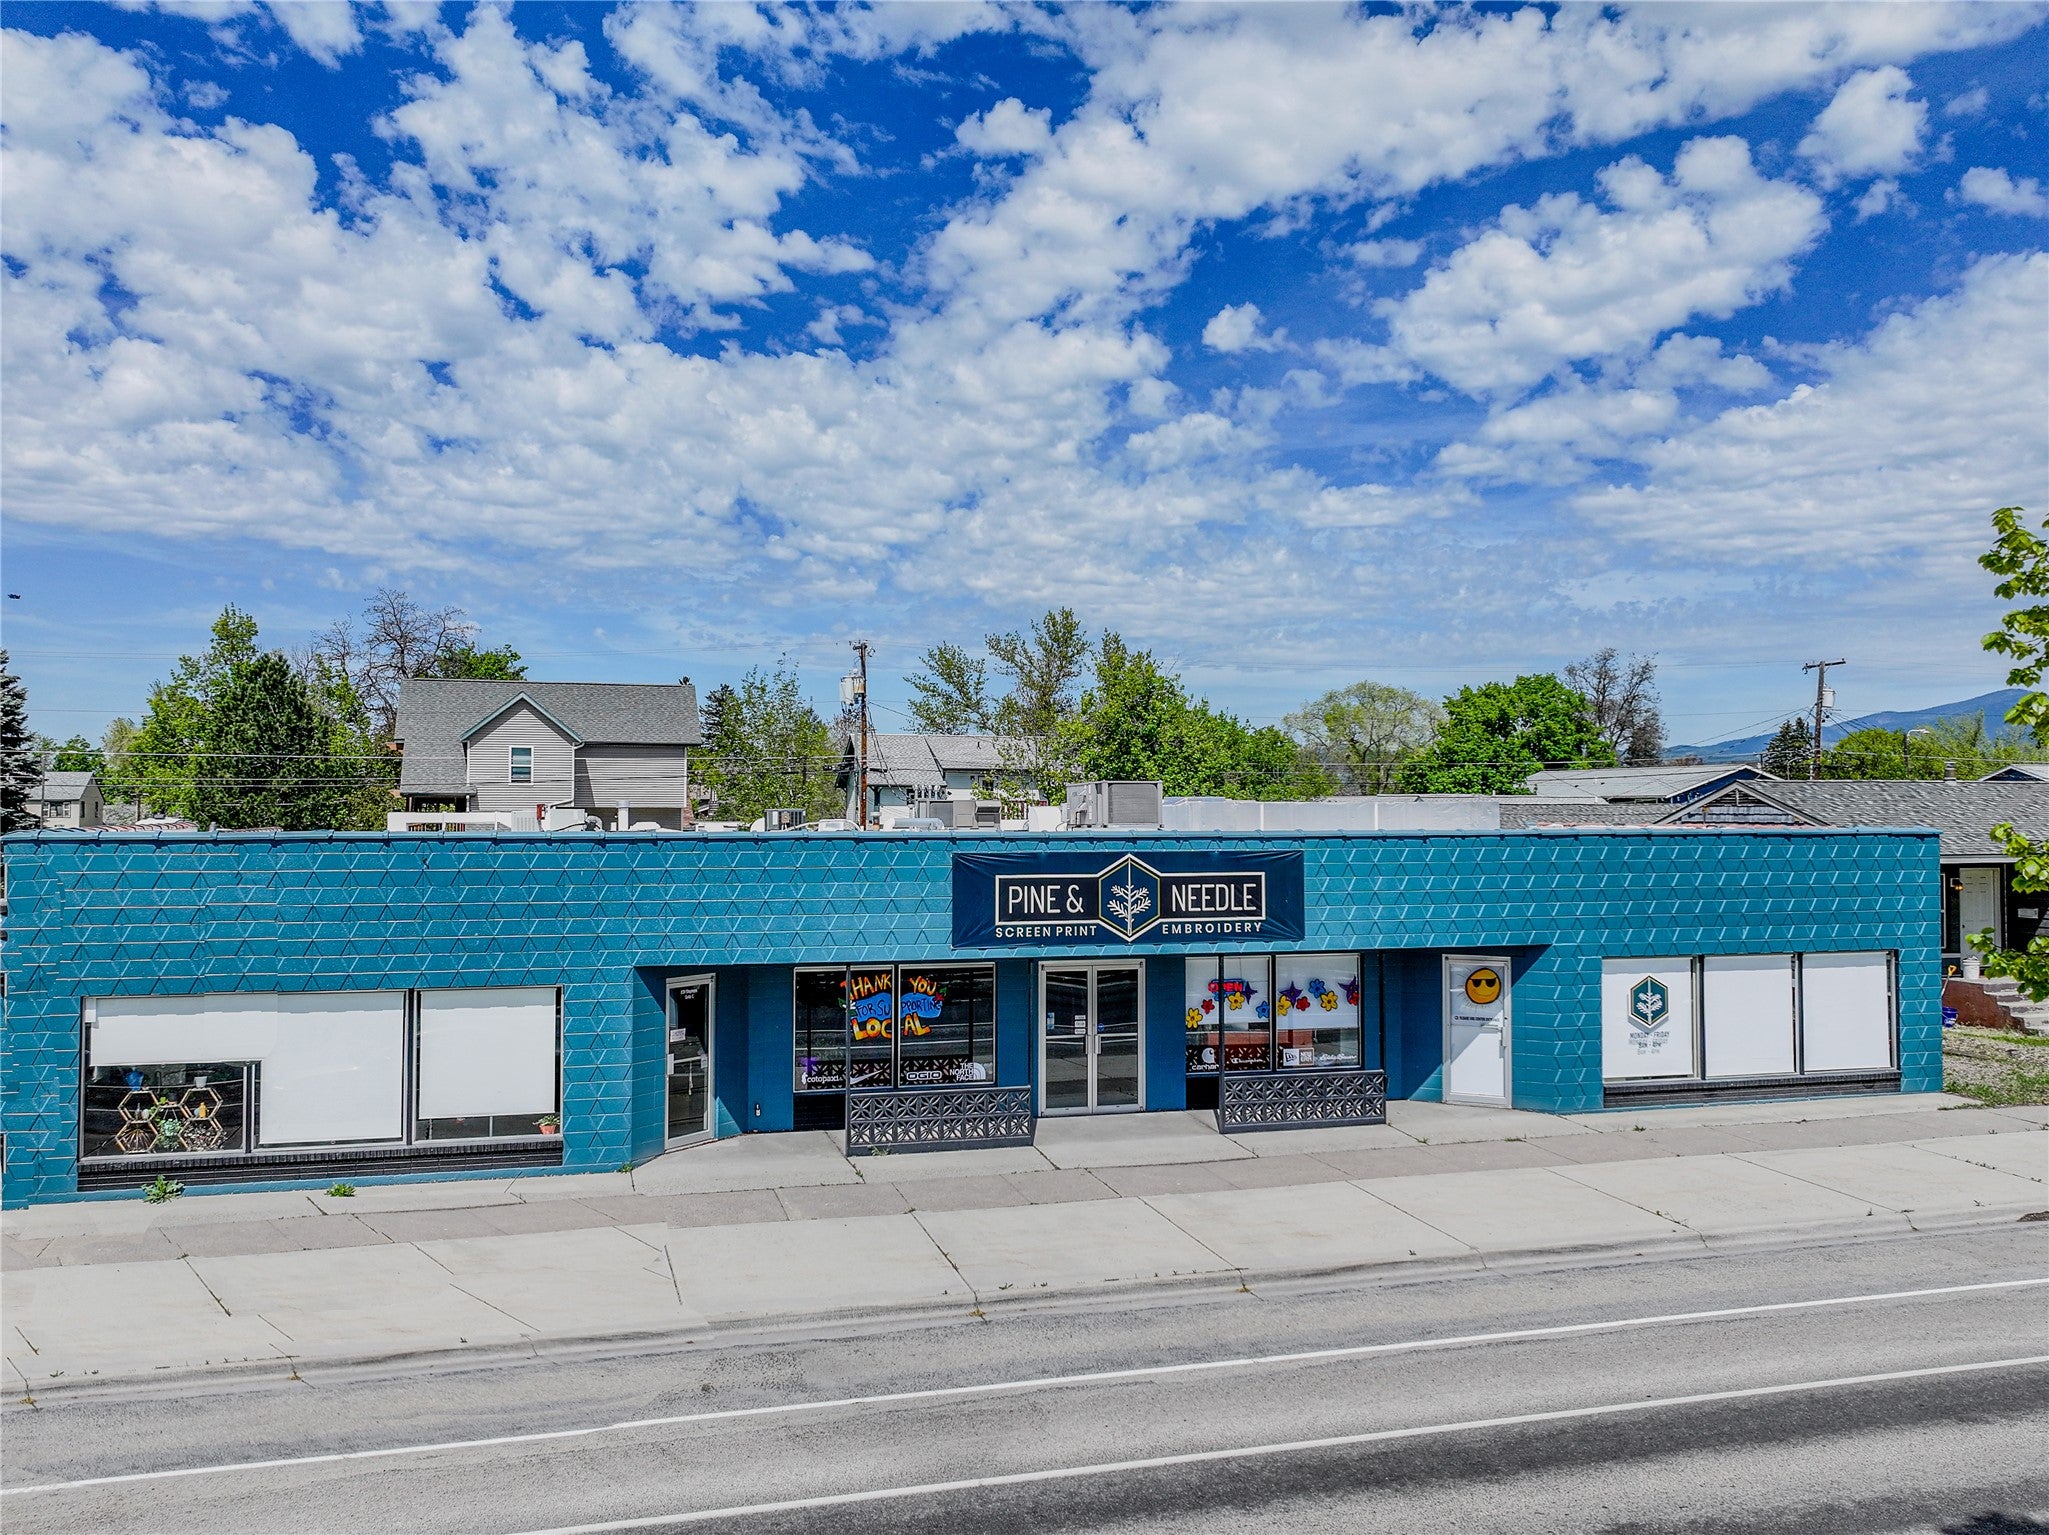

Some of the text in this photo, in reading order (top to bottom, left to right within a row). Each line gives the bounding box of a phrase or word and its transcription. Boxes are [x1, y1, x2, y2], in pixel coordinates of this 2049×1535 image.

[1008, 883, 1257, 914] PINE & NEEDLE
[995, 921, 1262, 939] SCREEN PRINT EMBROIDERY
[909, 975, 937, 996] YOU
[856, 997, 941, 1018] FOR SUPPORTING
[851, 1012, 932, 1040] LOCAL
[906, 1070, 943, 1081] OGIO
[949, 1068, 974, 1076] NORTH
